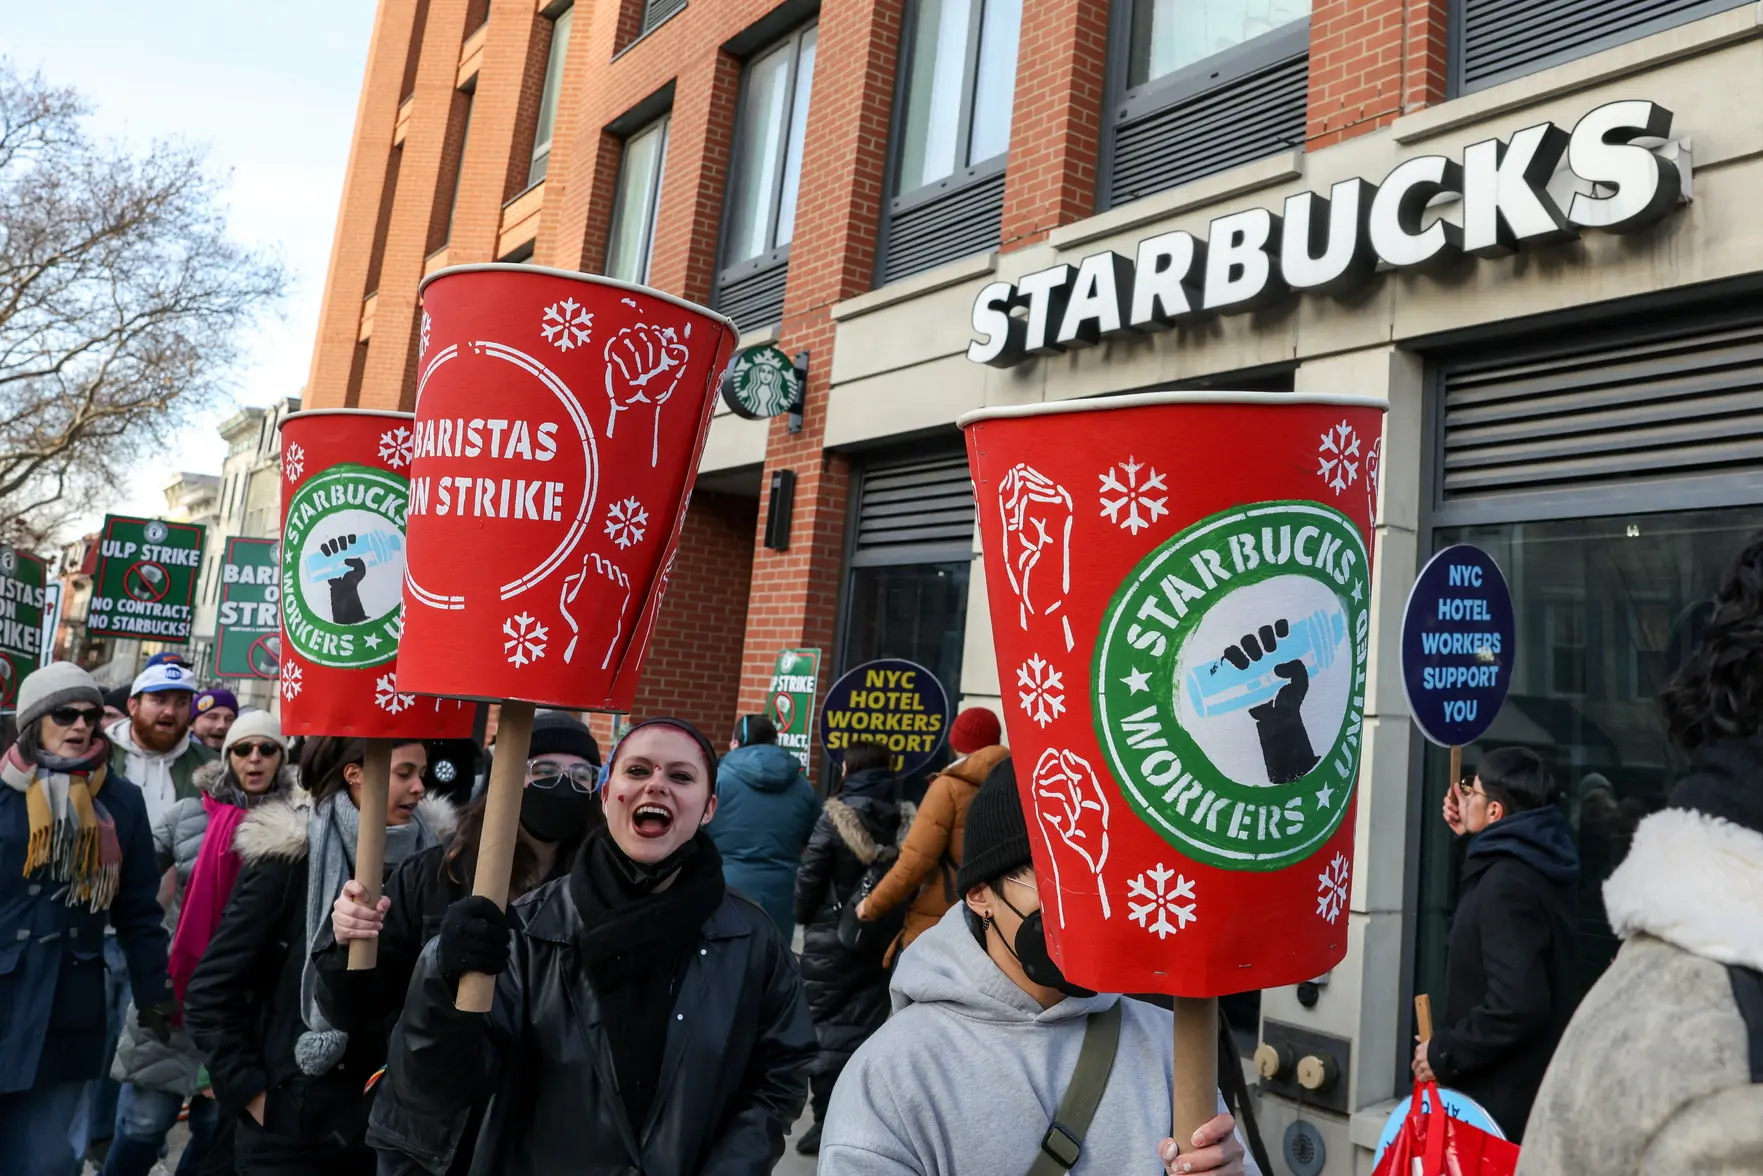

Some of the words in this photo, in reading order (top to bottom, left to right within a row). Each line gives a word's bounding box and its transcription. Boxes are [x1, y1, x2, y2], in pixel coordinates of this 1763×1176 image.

[967, 100, 1668, 368] STARBUCKS
[414, 418, 559, 462] BARISTAS
[408, 476, 430, 516] ON
[436, 476, 564, 521] STRIKE
[102, 540, 137, 558] ULP
[140, 544, 200, 567] STRIKE
[1449, 565, 1483, 587] NYC
[1126, 525, 1356, 657] STARBUCKS
[91, 597, 113, 613] NO
[117, 599, 192, 621] CONTRACT,
[283, 571, 354, 656] WORKERS
[1438, 598, 1491, 621] HOTEL
[88, 614, 108, 629] NO
[112, 616, 190, 636] STARBUCKS!
[1421, 632, 1501, 655] WORKERS
[777, 675, 814, 692] STRIKE
[866, 670, 916, 689] NYC
[1423, 666, 1499, 689] SUPPORT
[850, 690, 924, 710] HOTEL
[1334, 609, 1368, 778] UNITED
[827, 711, 941, 731] WORKERS
[1443, 700, 1477, 722] YOU
[1120, 705, 1305, 841] WORKERS
